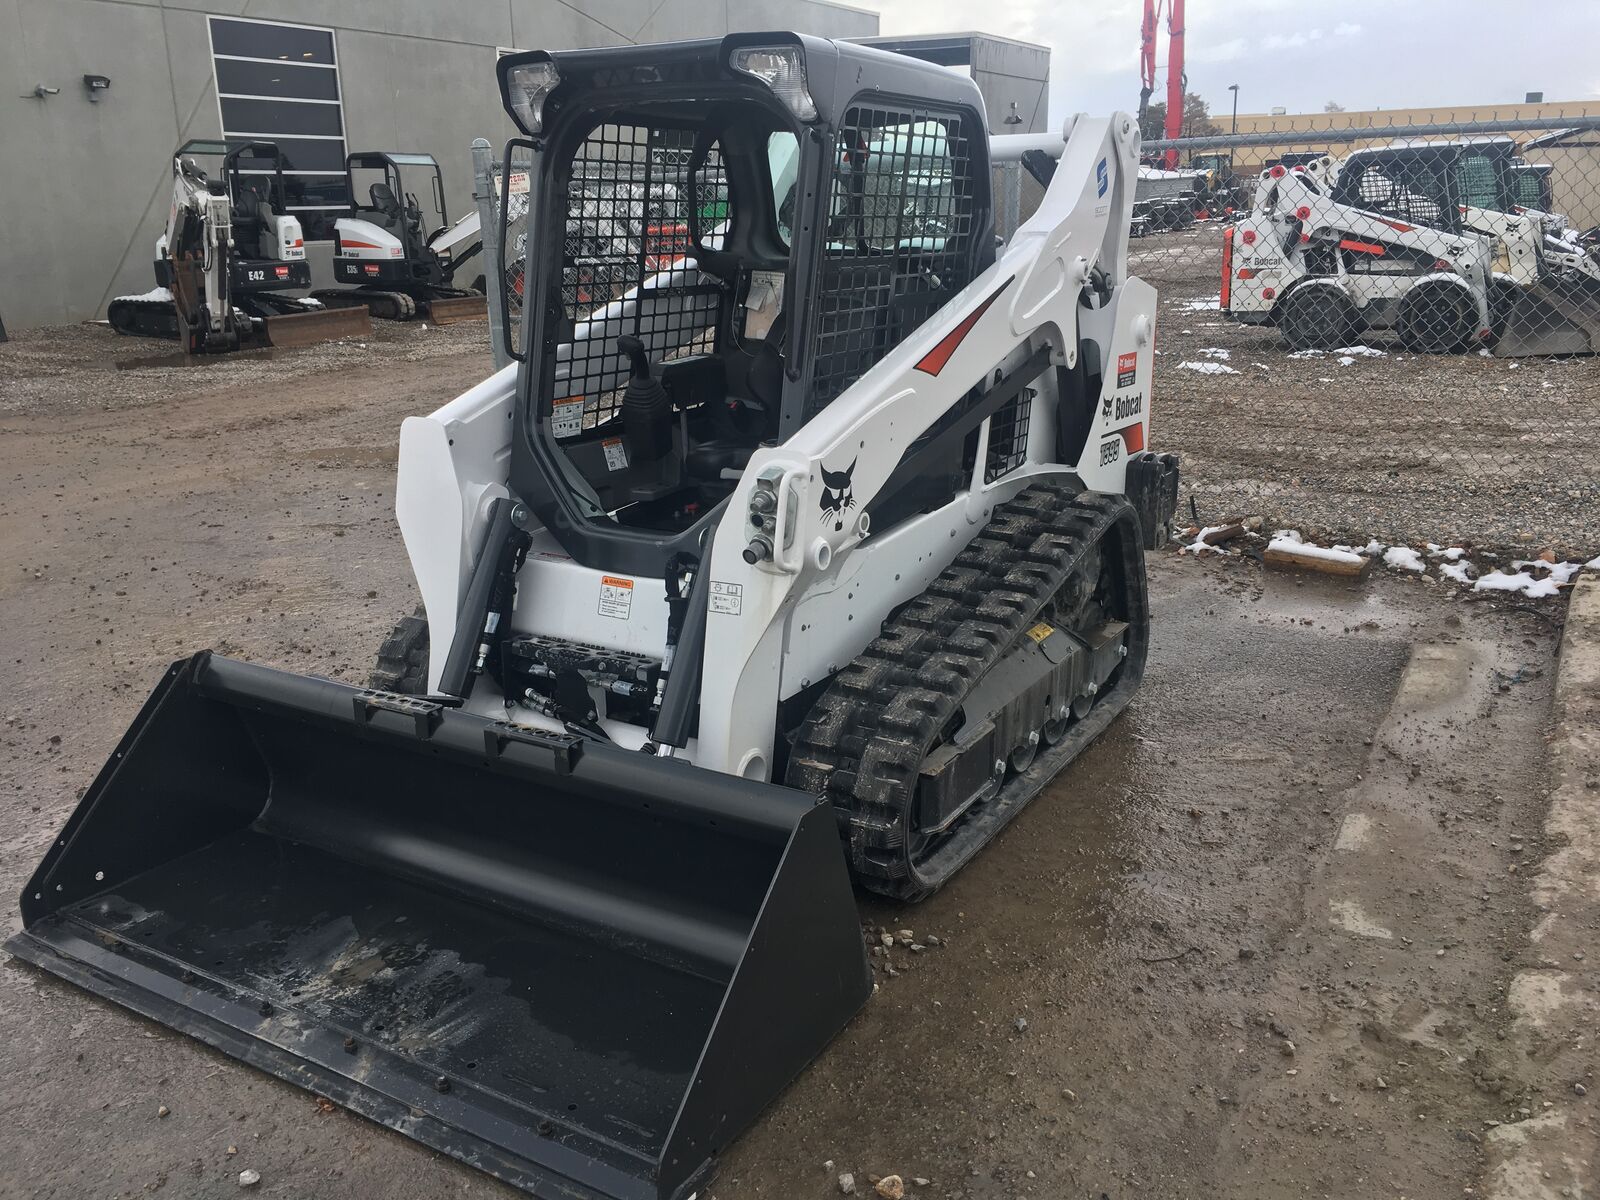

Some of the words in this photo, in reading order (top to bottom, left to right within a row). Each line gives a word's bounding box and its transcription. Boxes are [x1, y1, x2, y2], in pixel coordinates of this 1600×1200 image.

[1254, 257, 1281, 266] Bobcat
[248, 270, 265, 281] E42
[1115, 392, 1143, 421] Bobcat
[608, 579, 630, 587] WARNING
